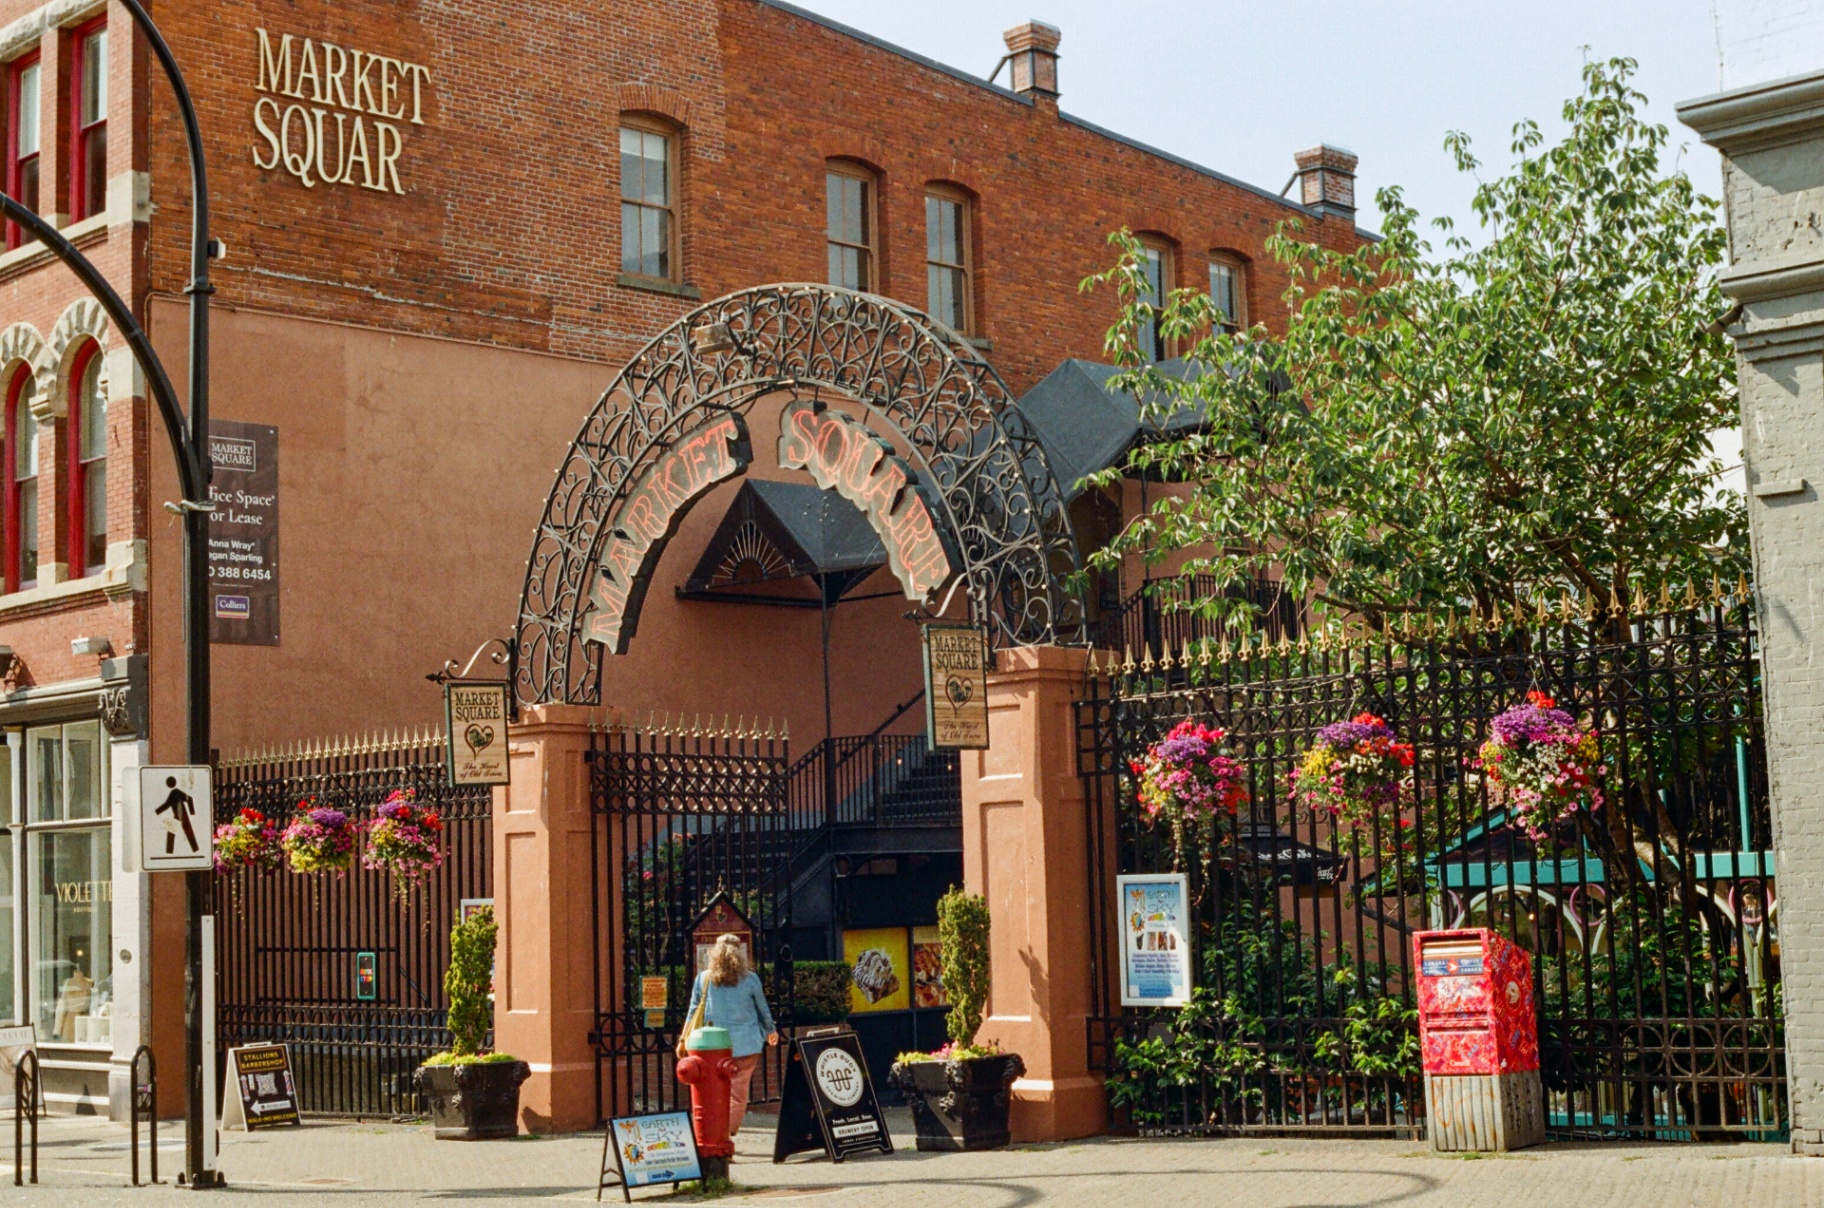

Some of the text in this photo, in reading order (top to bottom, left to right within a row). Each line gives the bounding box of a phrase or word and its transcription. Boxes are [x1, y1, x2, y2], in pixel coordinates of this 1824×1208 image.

[255, 27, 431, 125] MARKET
[252, 96, 406, 195] SQUAR
[211, 443, 252, 456] MARKET
[211, 452, 252, 465] SQUARE
[208, 486, 233, 503] fice
[209, 508, 263, 525] or Lease
[591, 409, 951, 637] MARKET SQUARE
[208, 551, 263, 564] egan Sparling
[218, 566, 240, 578] 388
[242, 568, 271, 580] 6454
[219, 599, 246, 609] Colliers
[934, 635, 978, 654] MARKET
[935, 653, 979, 673] SQUARE
[454, 691, 500, 706] MARKET
[455, 706, 501, 723] SQUARE
[943, 721, 956, 730] The
[463, 762, 500, 770] The Heart
[459, 770, 503, 780] of Old Town
[1147, 890, 1174, 900] EARTH
[1148, 904, 1175, 913] SKY
[244, 1052, 279, 1061] STALLIONS
[241, 1060, 283, 1069] BARBERSHOP
[820, 1052, 857, 1078] WHISTLE BUOY
[641, 1118, 680, 1129] EARTH
[645, 1131, 682, 1143] SKY
[838, 1126, 860, 1135] BREWERY
